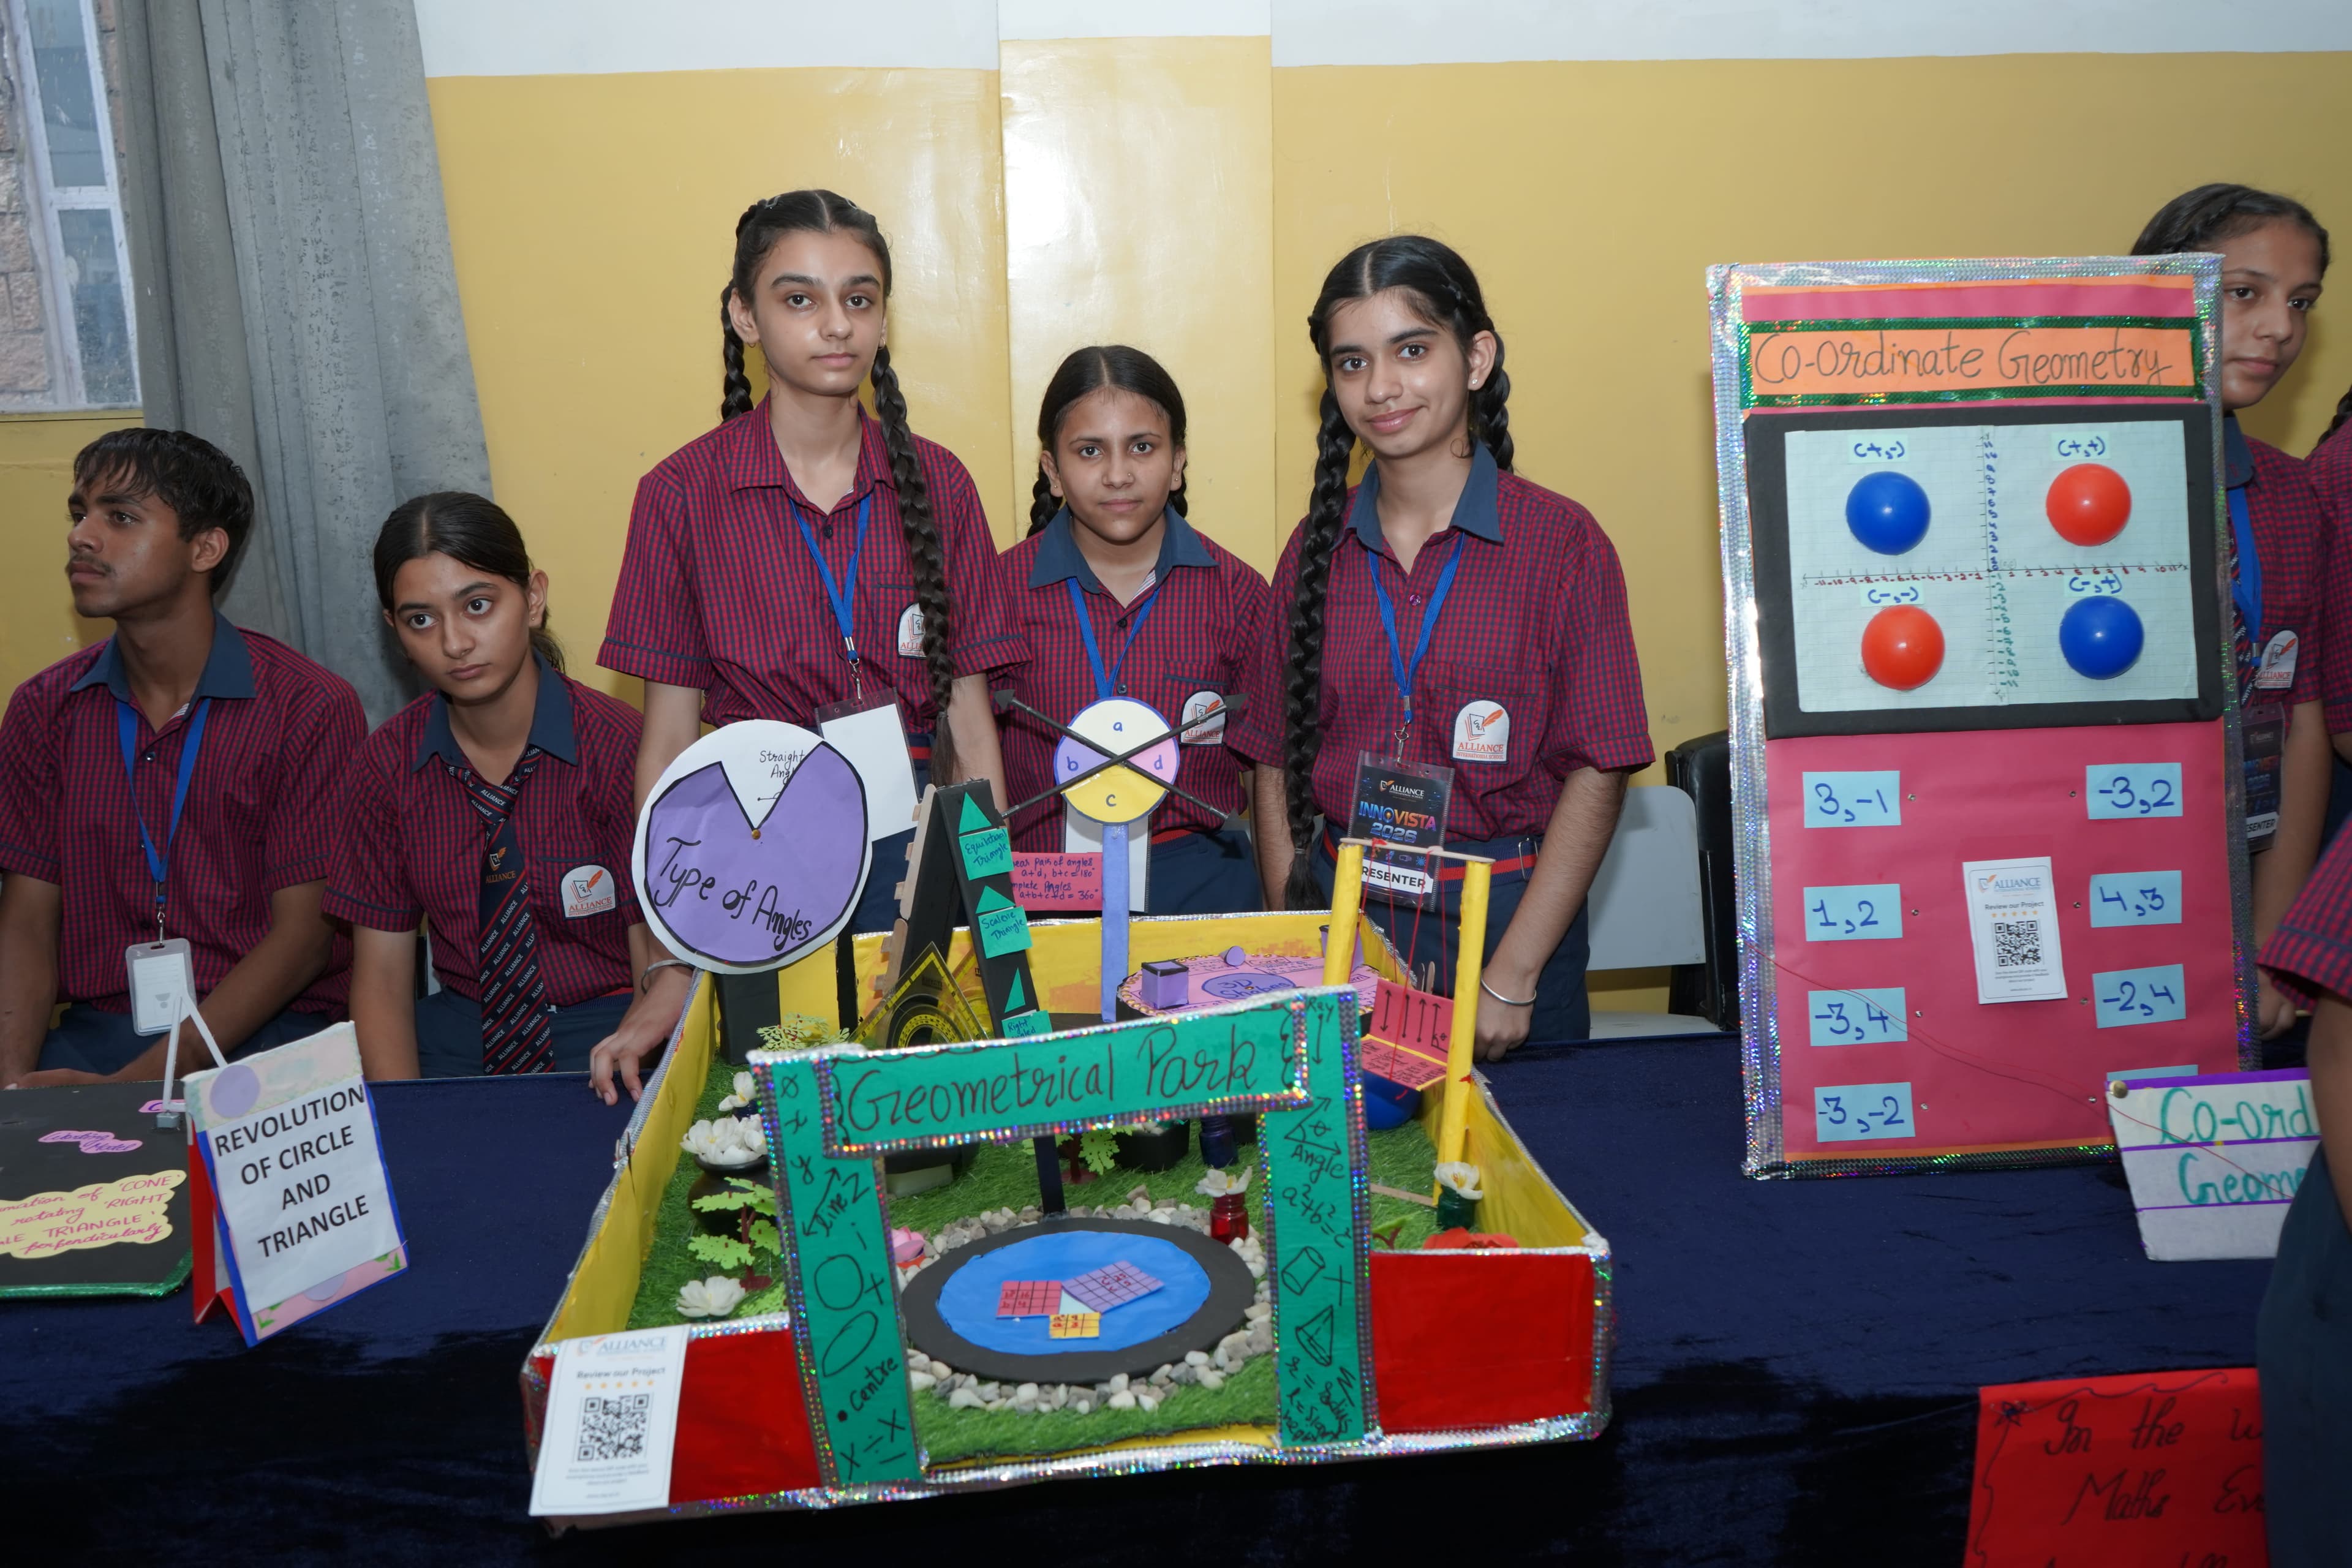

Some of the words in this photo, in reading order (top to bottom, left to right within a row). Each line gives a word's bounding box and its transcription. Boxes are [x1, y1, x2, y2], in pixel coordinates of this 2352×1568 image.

[1998, 328, 2173, 385] Geometry
[2057, 436, 2105, 457] (+,+)
[1113, 721, 1123, 732] a
[1458, 742, 1504, 752] ALLIANCE
[760, 749, 805, 771] Straight
[1066, 756, 1079, 772] b
[1154, 755, 1164, 771] d
[480, 789, 507, 806] ALLIANCE
[1390, 784, 1425, 797] ALLIANCE
[2098, 775, 2174, 814] -3,2
[471, 799, 492, 817] ALLIANCE
[1814, 783, 1888, 823] 3,-1
[1359, 801, 1436, 831] INNOVISTA
[1370, 823, 1417, 843] 2026
[973, 843, 1008, 867] Triangle
[1054, 856, 1063, 867] of
[486, 870, 516, 883] ALLIANCE
[1011, 881, 1038, 891] mplete
[1362, 867, 1425, 888] RESENTER
[1994, 877, 2041, 889] ALLIANCE
[569, 896, 612, 911] ALLIANCE
[654, 837, 716, 907] Type
[722, 880, 757, 919] of
[752, 885, 812, 951] Angles
[2100, 886, 2165, 917] 4,3
[500, 900, 518, 924] ALLIANCE
[1812, 899, 1879, 933] 1,2
[513, 912, 530, 937] ALLIANCE
[481, 930, 499, 954] ALLIANCE
[493, 942, 511, 965] ALLIANCE
[505, 954, 524, 977] ALLIANCE
[517, 965, 537, 988] ALLIANCE
[484, 981, 502, 1003] ALLIANCE
[497, 992, 515, 1014] ALLIANCE
[2103, 980, 2176, 1016] -2,4
[510, 1003, 529, 1025] ALLIANCE
[521, 1013, 542, 1036] ALLIANCE
[1814, 1003, 1889, 1041] -3,4
[485, 1029, 505, 1049] ALLIANCE
[498, 1041, 518, 1061] ALLIANCE
[511, 1050, 532, 1071] ALLIANCE
[849, 1044, 1115, 1132] Geometrical
[1137, 1023, 1258, 1099] Park
[215, 1084, 365, 1156] REVOLUTION
[1817, 1096, 1905, 1133] -3,-2
[2160, 1085, 2321, 1144] Co-ord
[241, 1156, 271, 1185] OF
[279, 1125, 355, 1171] CIRCLE
[1291, 1145, 1345, 1184] Angle
[0, 1196, 66, 1212] mation
[77, 1186, 103, 1201] of
[282, 1173, 331, 1210] AND
[257, 1194, 369, 1257] TRIANGLE
[599, 1336, 668, 1353] ALLIANCE
[577, 1369, 610, 1379] Review
[612, 1369, 628, 1378] our
[631, 1366, 666, 1378] Project
[850, 1357, 898, 1411] Centre
[2130, 1396, 2185, 1449] the
[2062, 1468, 2171, 1526] Maths
